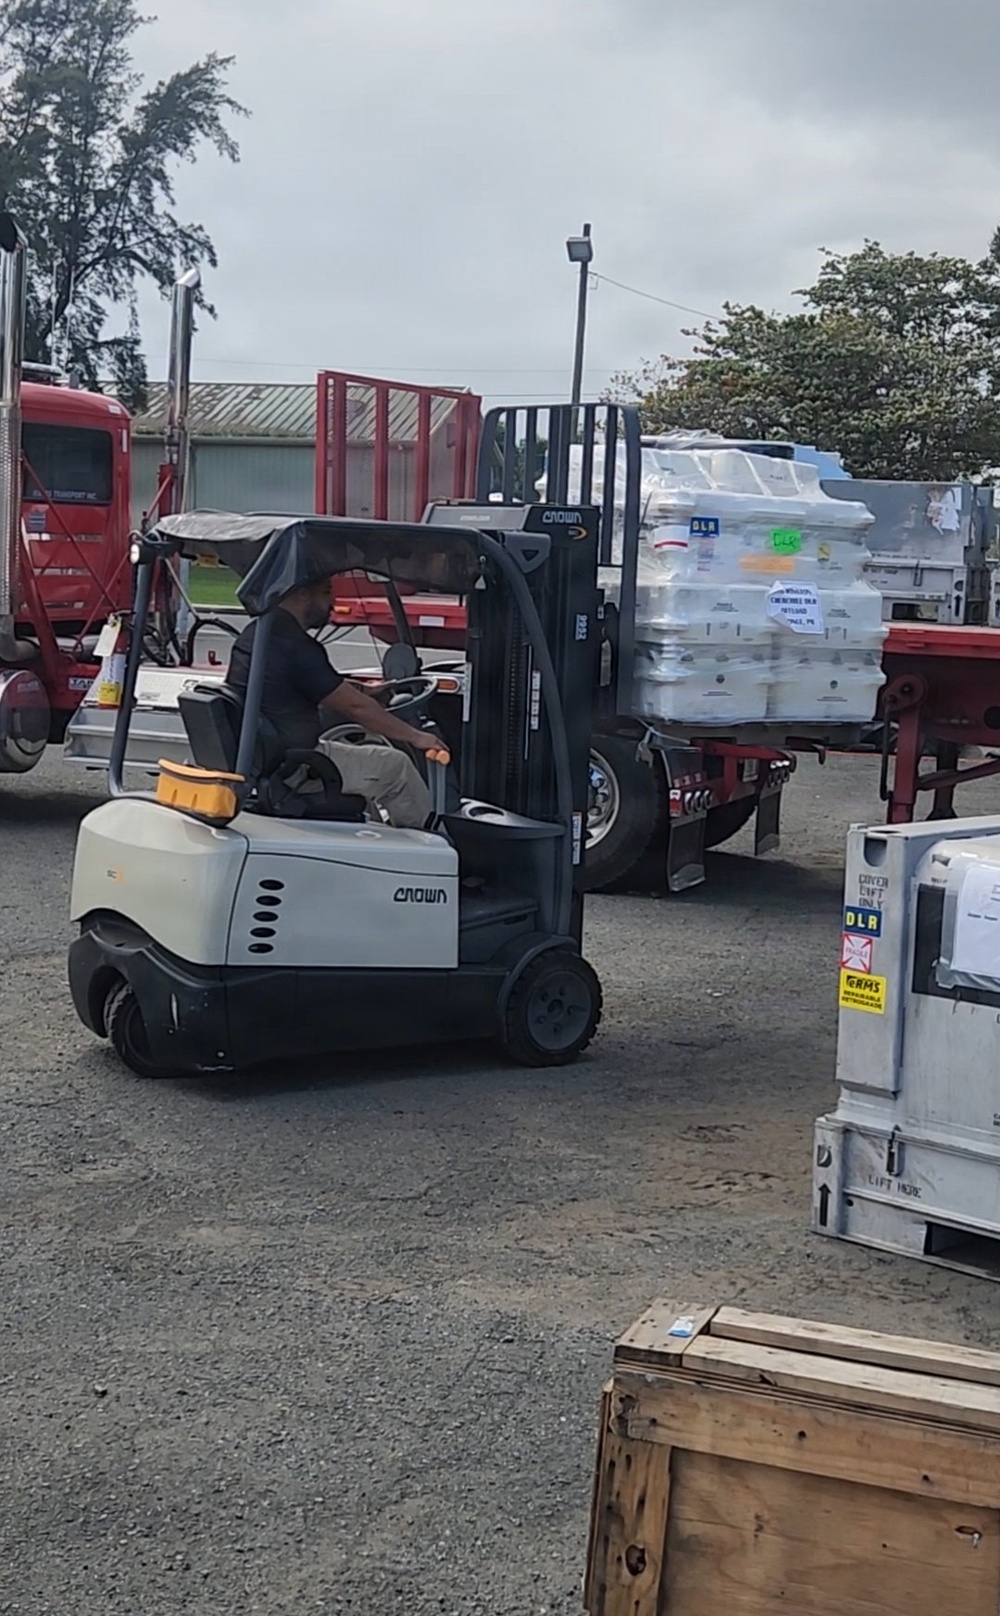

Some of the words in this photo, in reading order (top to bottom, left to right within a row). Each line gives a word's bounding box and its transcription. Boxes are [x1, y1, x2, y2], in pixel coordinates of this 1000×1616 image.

[542, 510, 582, 524] CROWN
[692, 520, 716, 533] DLR
[773, 532, 797, 550] DLR
[858, 873, 889, 888] COVER
[393, 886, 448, 904] CROWN
[858, 884, 884, 899] LIFT
[845, 911, 878, 930] DLR
[845, 946, 868, 959] FRAGILE
[847, 976, 881, 994] eRMS
[841, 995, 883, 1010] RETROGRADE
[843, 989, 881, 1003] REPAIRABLE
[868, 1173, 893, 1190] LIFT
[897, 1181, 922, 1199] HERE
